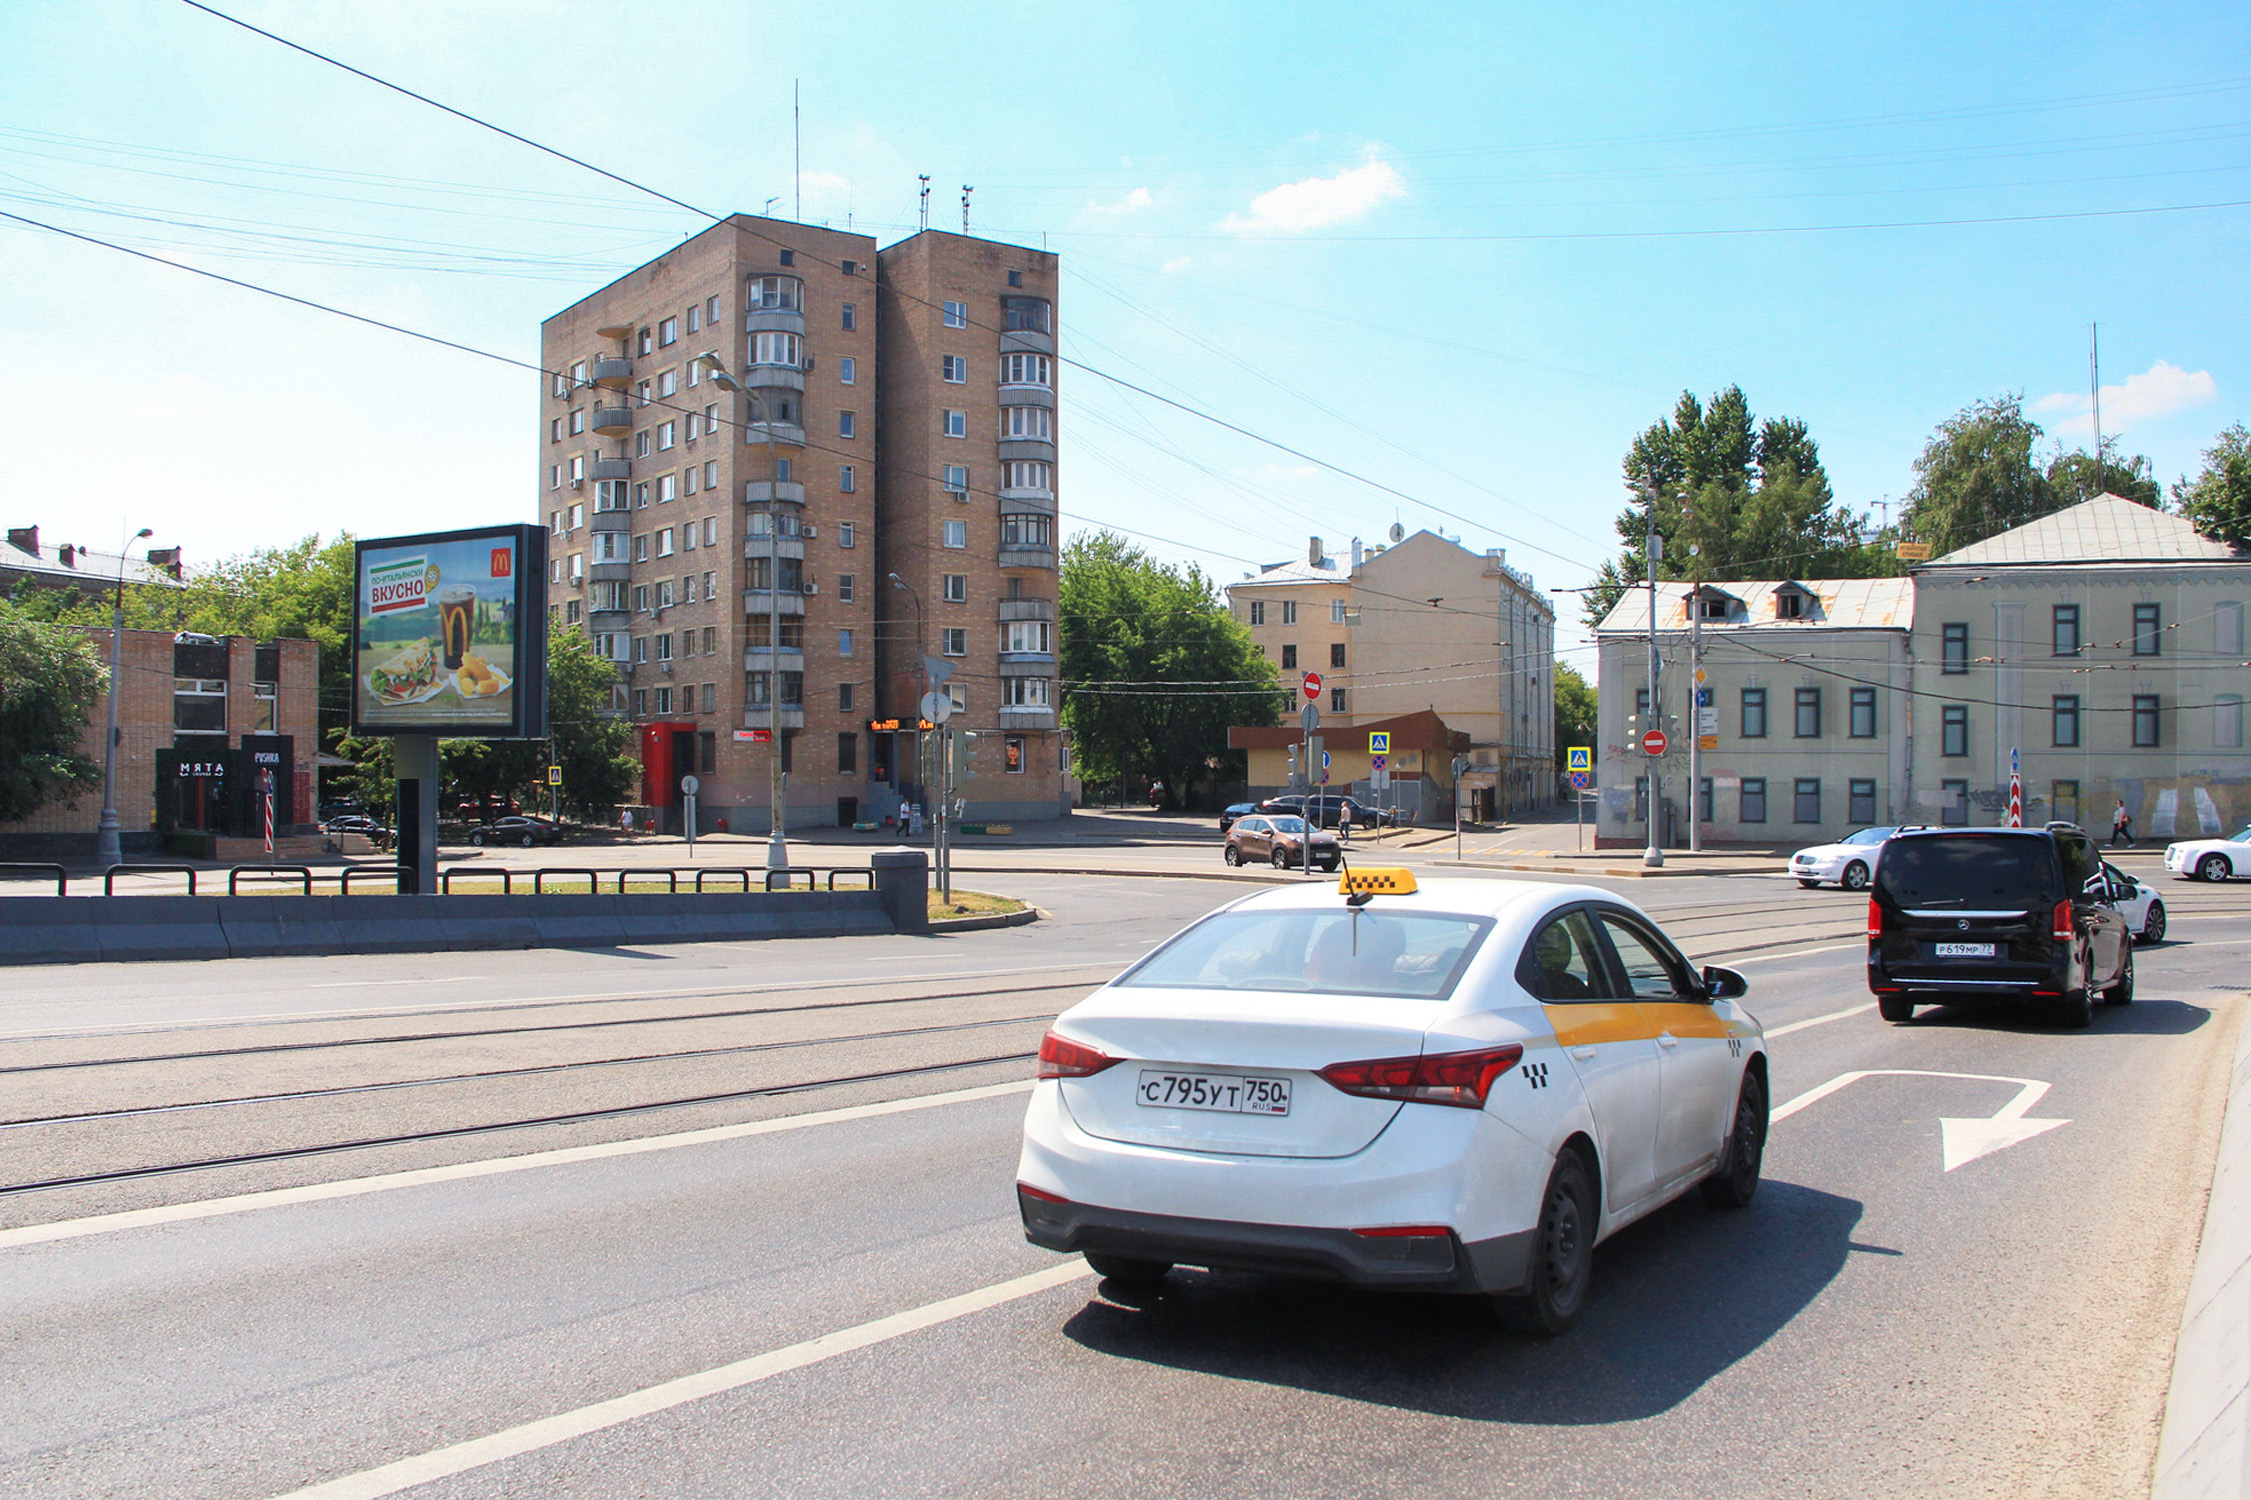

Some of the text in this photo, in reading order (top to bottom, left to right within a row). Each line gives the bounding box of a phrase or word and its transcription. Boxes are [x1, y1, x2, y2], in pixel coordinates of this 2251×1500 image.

[372, 579, 424, 604] ВКУСНО
[254, 752, 280, 764] PUSHKA
[179, 763, 224, 773] МЯТА
[1145, 1076, 1283, 1107] С795УТ 750
[1251, 1102, 1272, 1112] RUS
